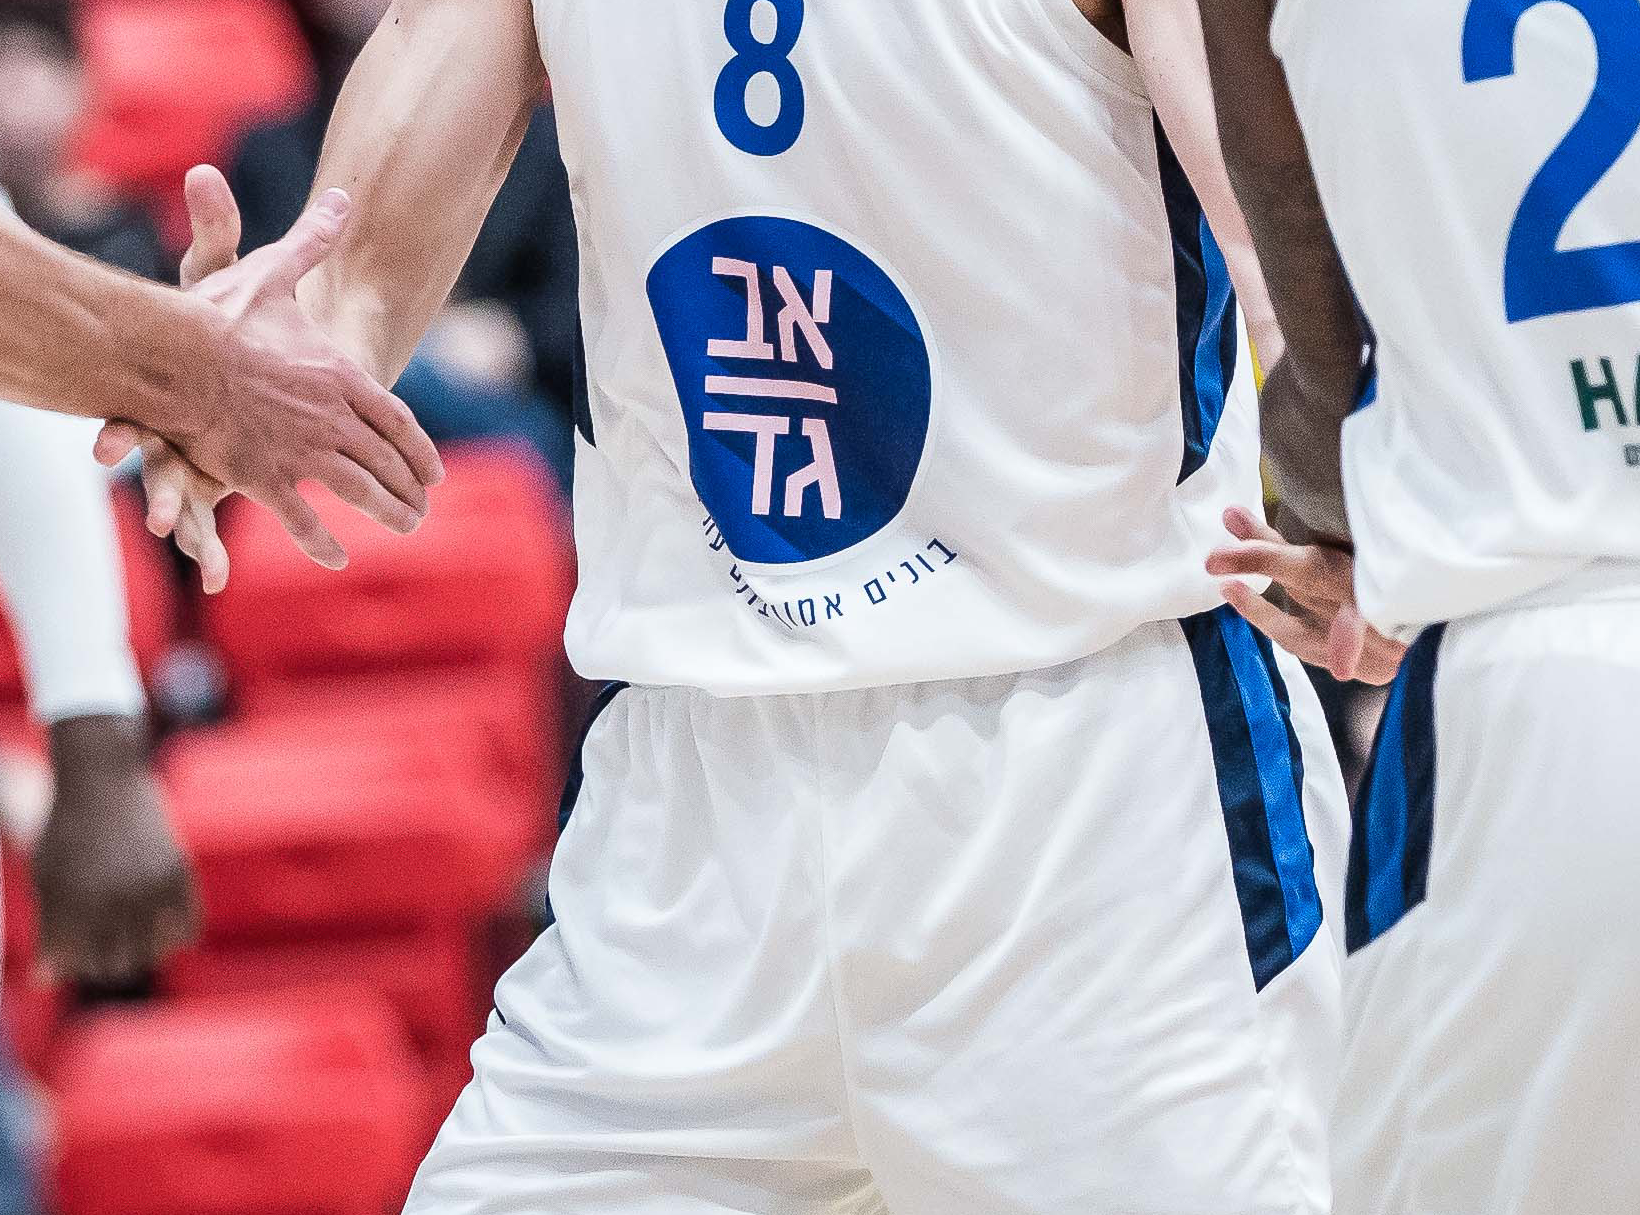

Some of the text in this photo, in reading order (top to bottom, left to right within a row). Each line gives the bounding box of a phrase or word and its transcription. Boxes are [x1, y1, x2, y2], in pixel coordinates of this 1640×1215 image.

[707, 256, 833, 370] אב
[703, 411, 842, 520] גד
[863, 538, 958, 605] בונים
